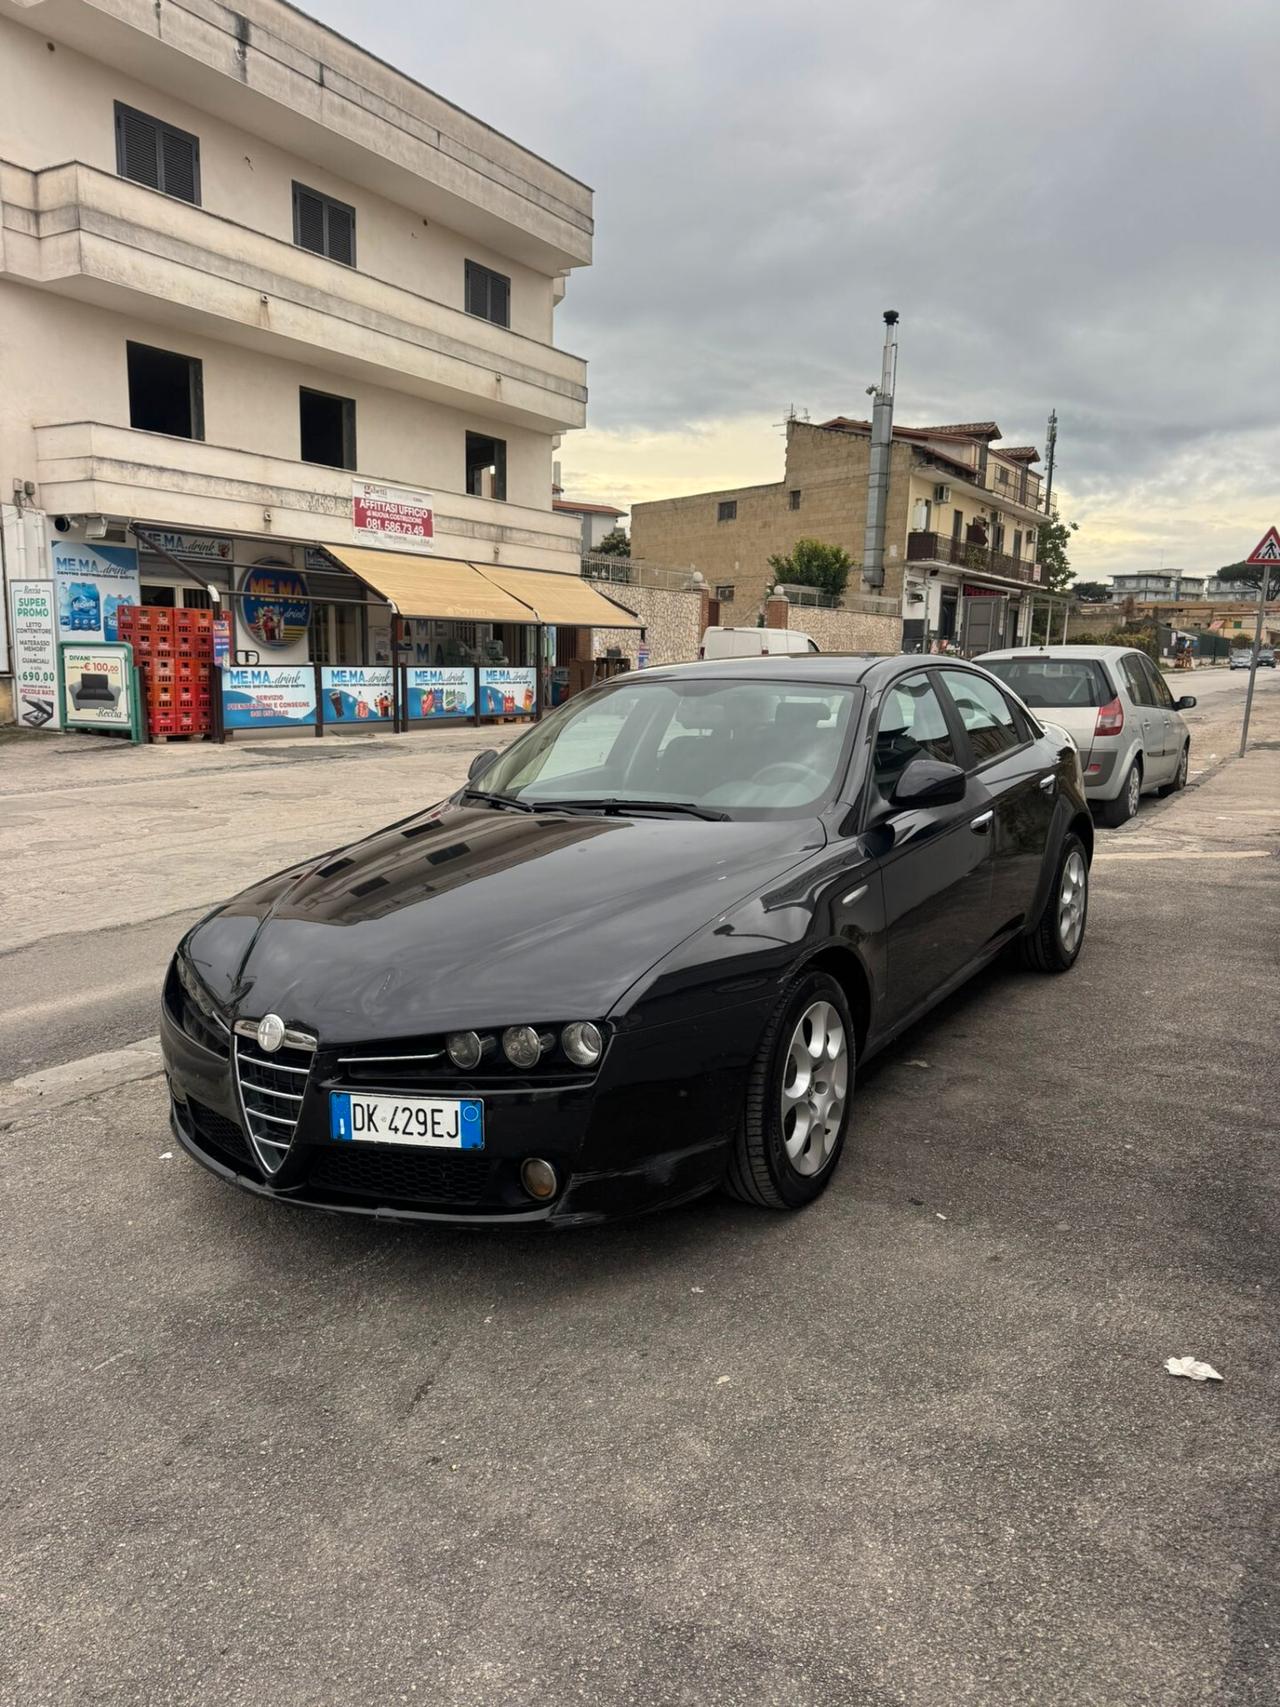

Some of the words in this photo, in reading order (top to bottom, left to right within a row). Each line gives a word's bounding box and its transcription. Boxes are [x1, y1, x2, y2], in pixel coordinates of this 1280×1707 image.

[360, 499, 398, 514] AFFITTASI
[399, 504, 428, 518] UFFICIO
[372, 511, 389, 519] NUOVA
[18, 597, 47, 607] SUPER
[17, 607, 49, 617] PROMO
[353, 1103, 379, 1133] DK
[388, 1106, 459, 1138] 429EJ
